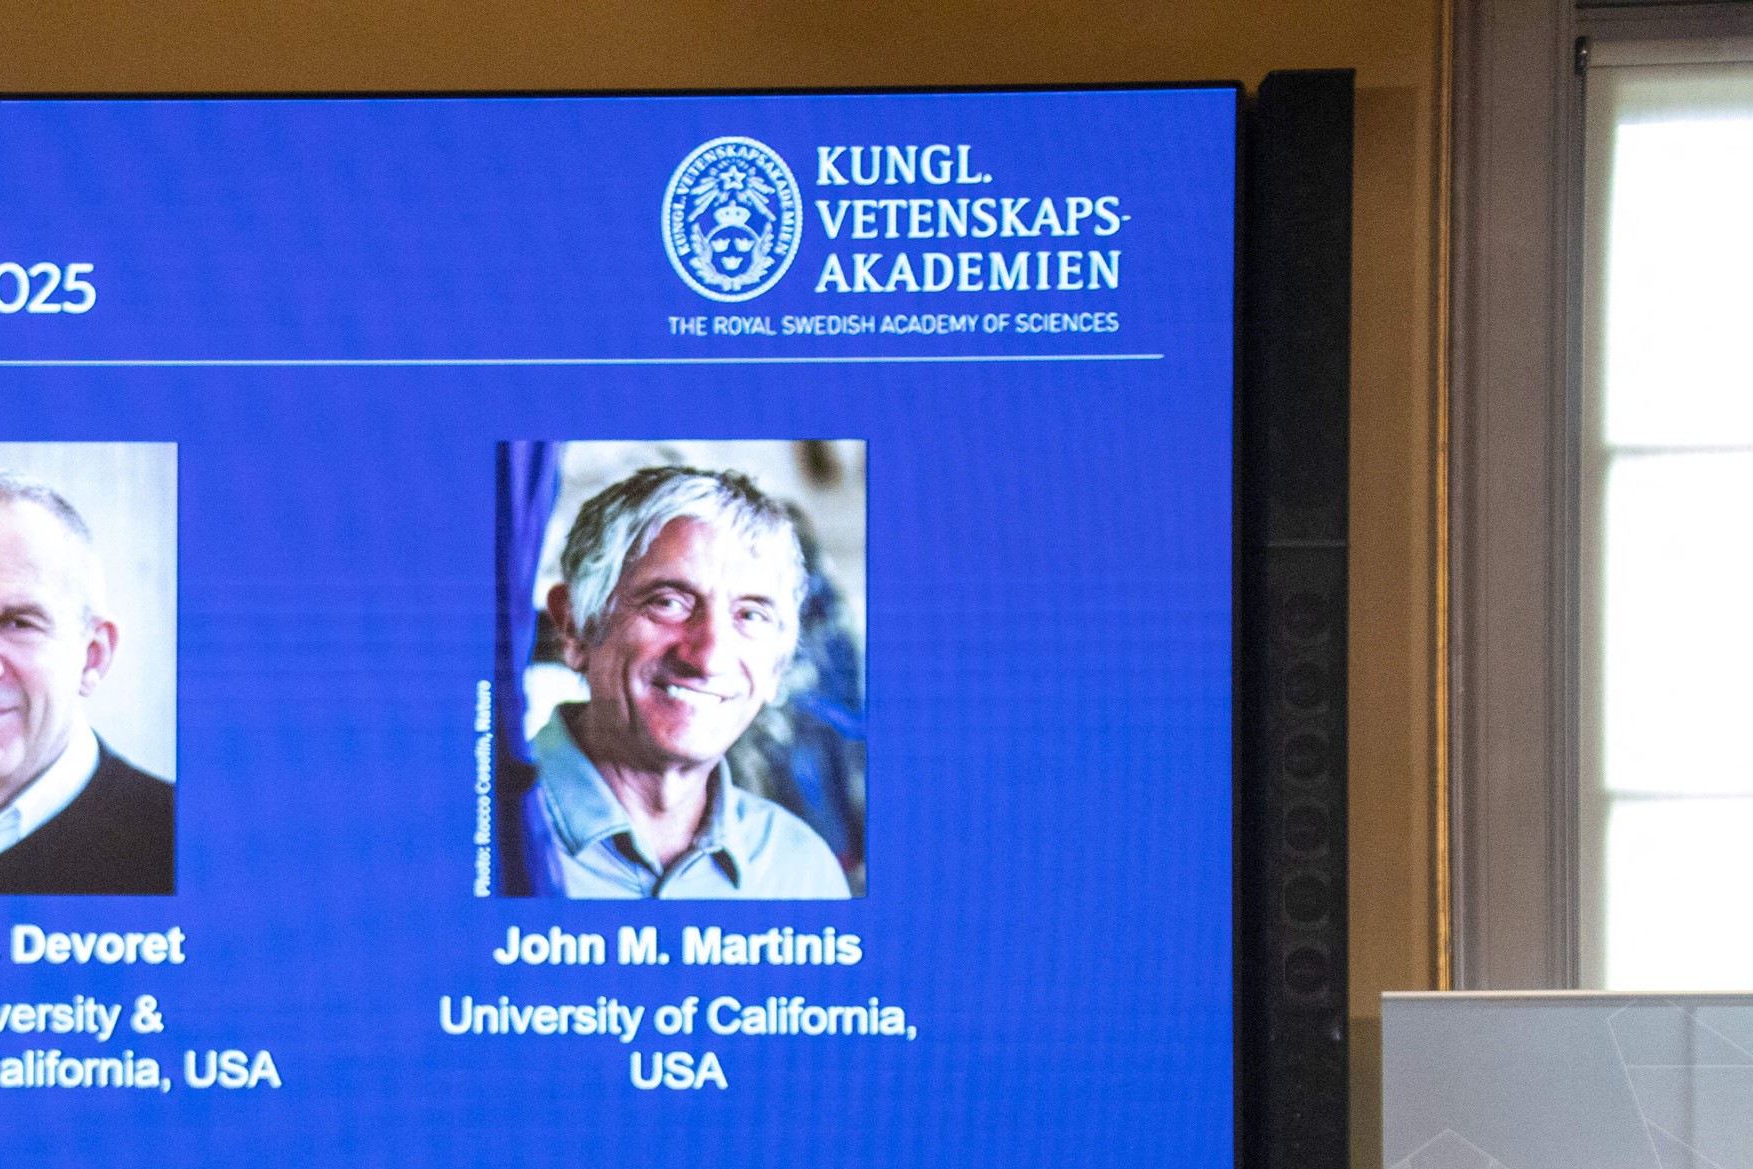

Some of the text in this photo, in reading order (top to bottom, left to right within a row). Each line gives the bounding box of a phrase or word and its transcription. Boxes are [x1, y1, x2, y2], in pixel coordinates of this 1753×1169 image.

[816, 143, 993, 186] KUNGL.
[815, 195, 1132, 240] VETENSKAPS-
[814, 249, 1122, 294] AKADEMIEN
[668, 311, 1120, 336] THE ROYAL SWEDISH ACADEMY OF SCIENCES
[474, 795, 492, 846] Rocco
[473, 846, 492, 897] Photo:
[11, 923, 187, 965] Devoret
[493, 925, 864, 966] John M. Martinis
[131, 993, 165, 1034] &
[440, 994, 918, 1044] University of California,
[184, 1049, 283, 1089] USA
[630, 1050, 729, 1091] USA
